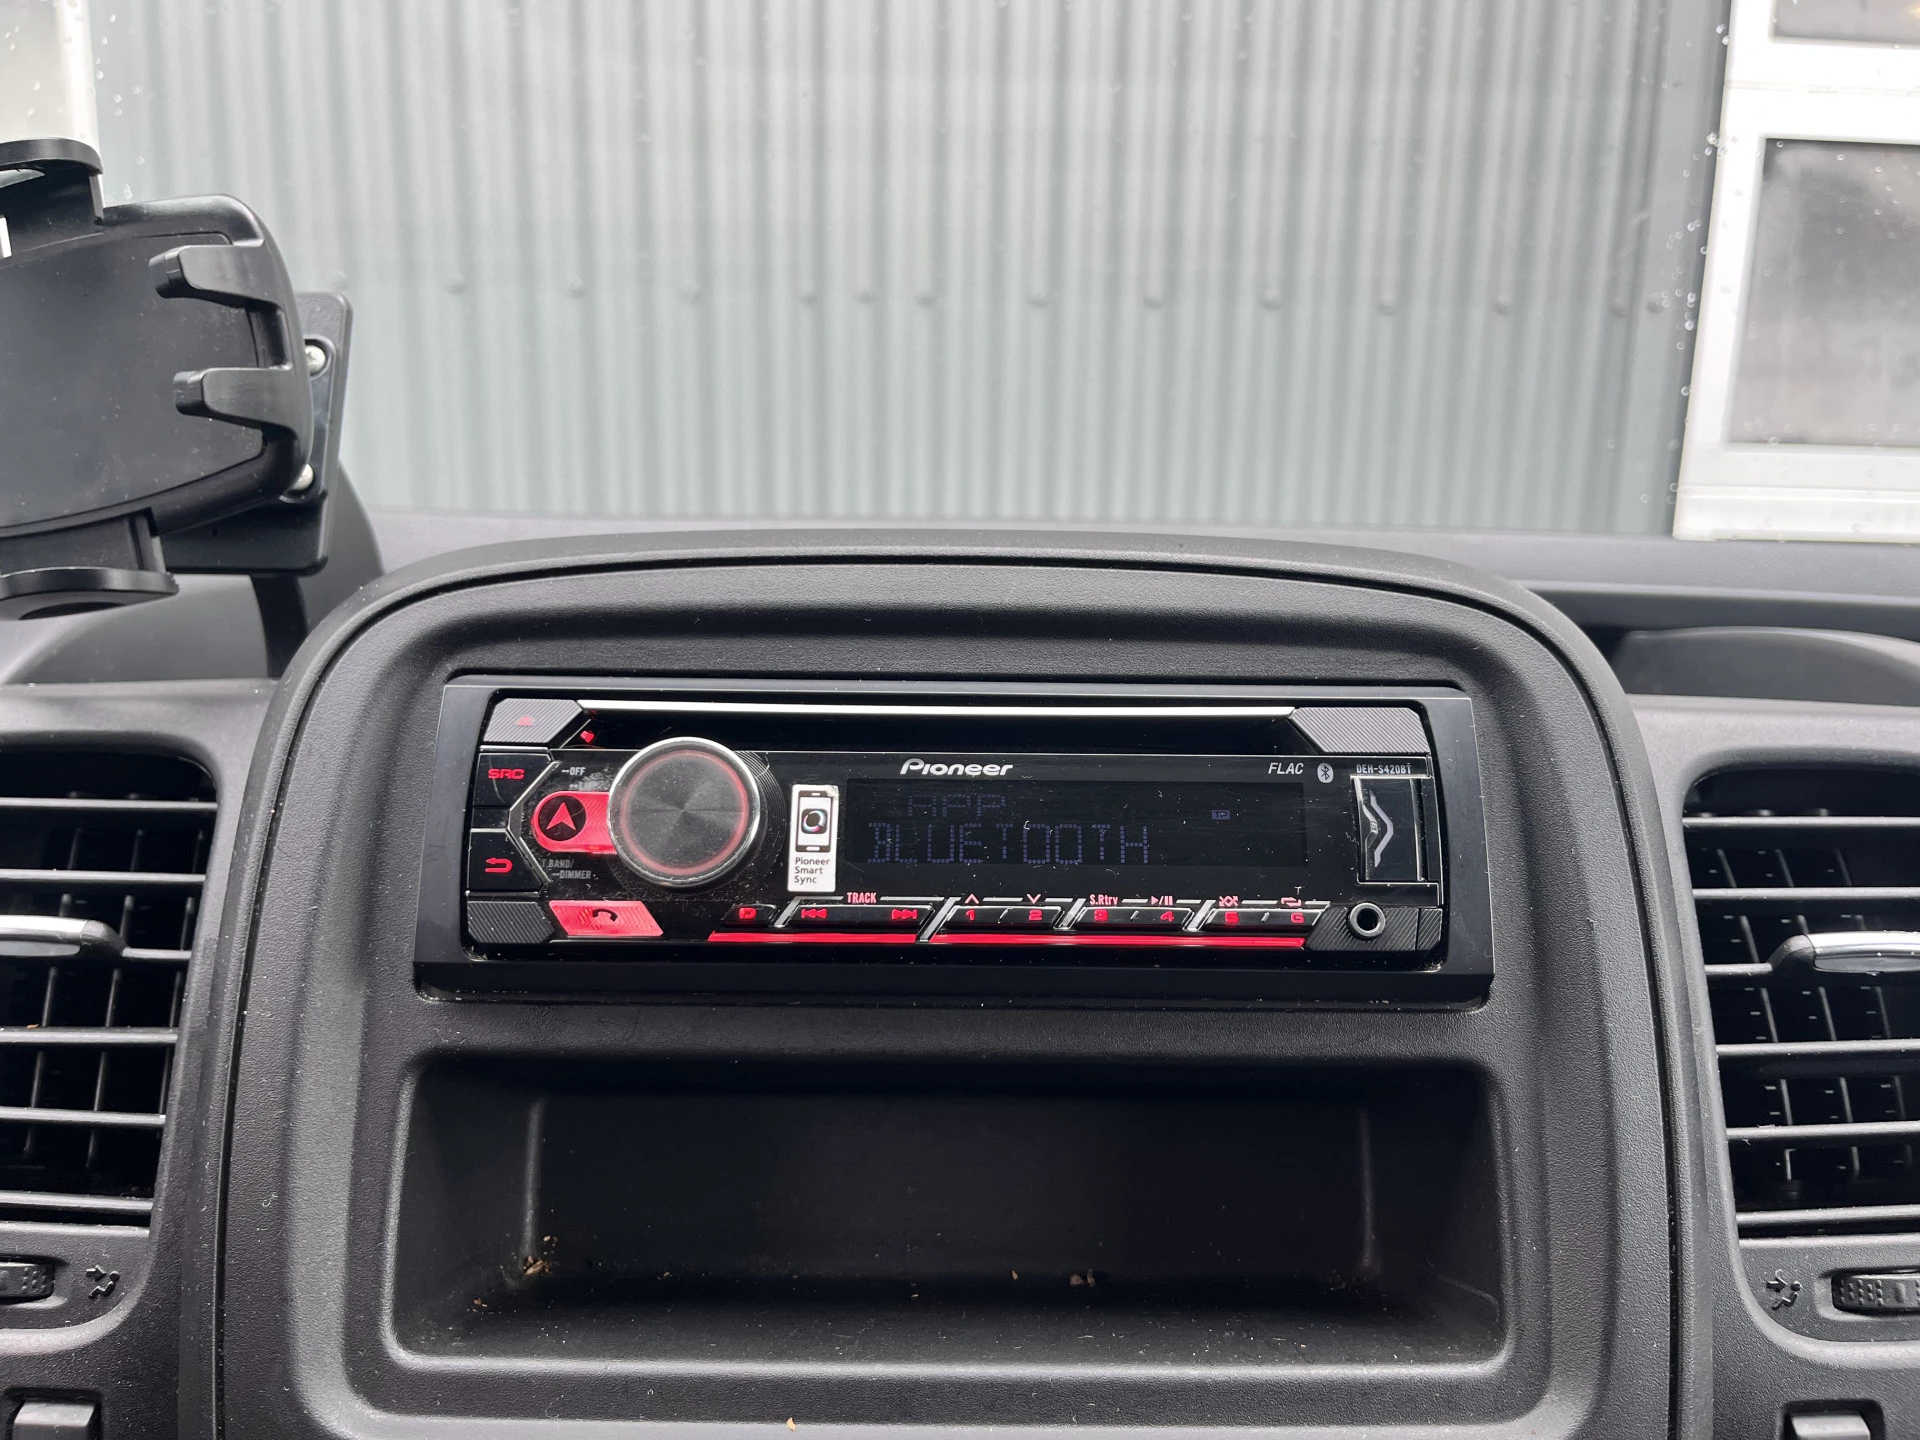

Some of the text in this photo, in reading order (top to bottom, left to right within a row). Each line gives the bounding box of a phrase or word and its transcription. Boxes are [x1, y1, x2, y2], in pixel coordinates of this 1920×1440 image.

[900, 758, 1014, 777] Pioneer
[1268, 763, 1304, 775] FLAC
[1356, 763, 1412, 775] DEH-S420BT
[488, 768, 525, 780] SRC
[908, 795, 1006, 818] APP
[868, 822, 1149, 865] BLUETOOTH
[795, 857, 830, 866] Pioneer
[795, 866, 823, 875] Smart
[794, 875, 817, 886] Sync
[846, 892, 877, 904] TRACK
[1089, 894, 1119, 906] S.Rtrv
[965, 909, 976, 921] 1
[1028, 909, 1043, 921] 2
[1094, 909, 1109, 922] 3
[1159, 910, 1175, 922] 4
[1224, 911, 1240, 924] 5
